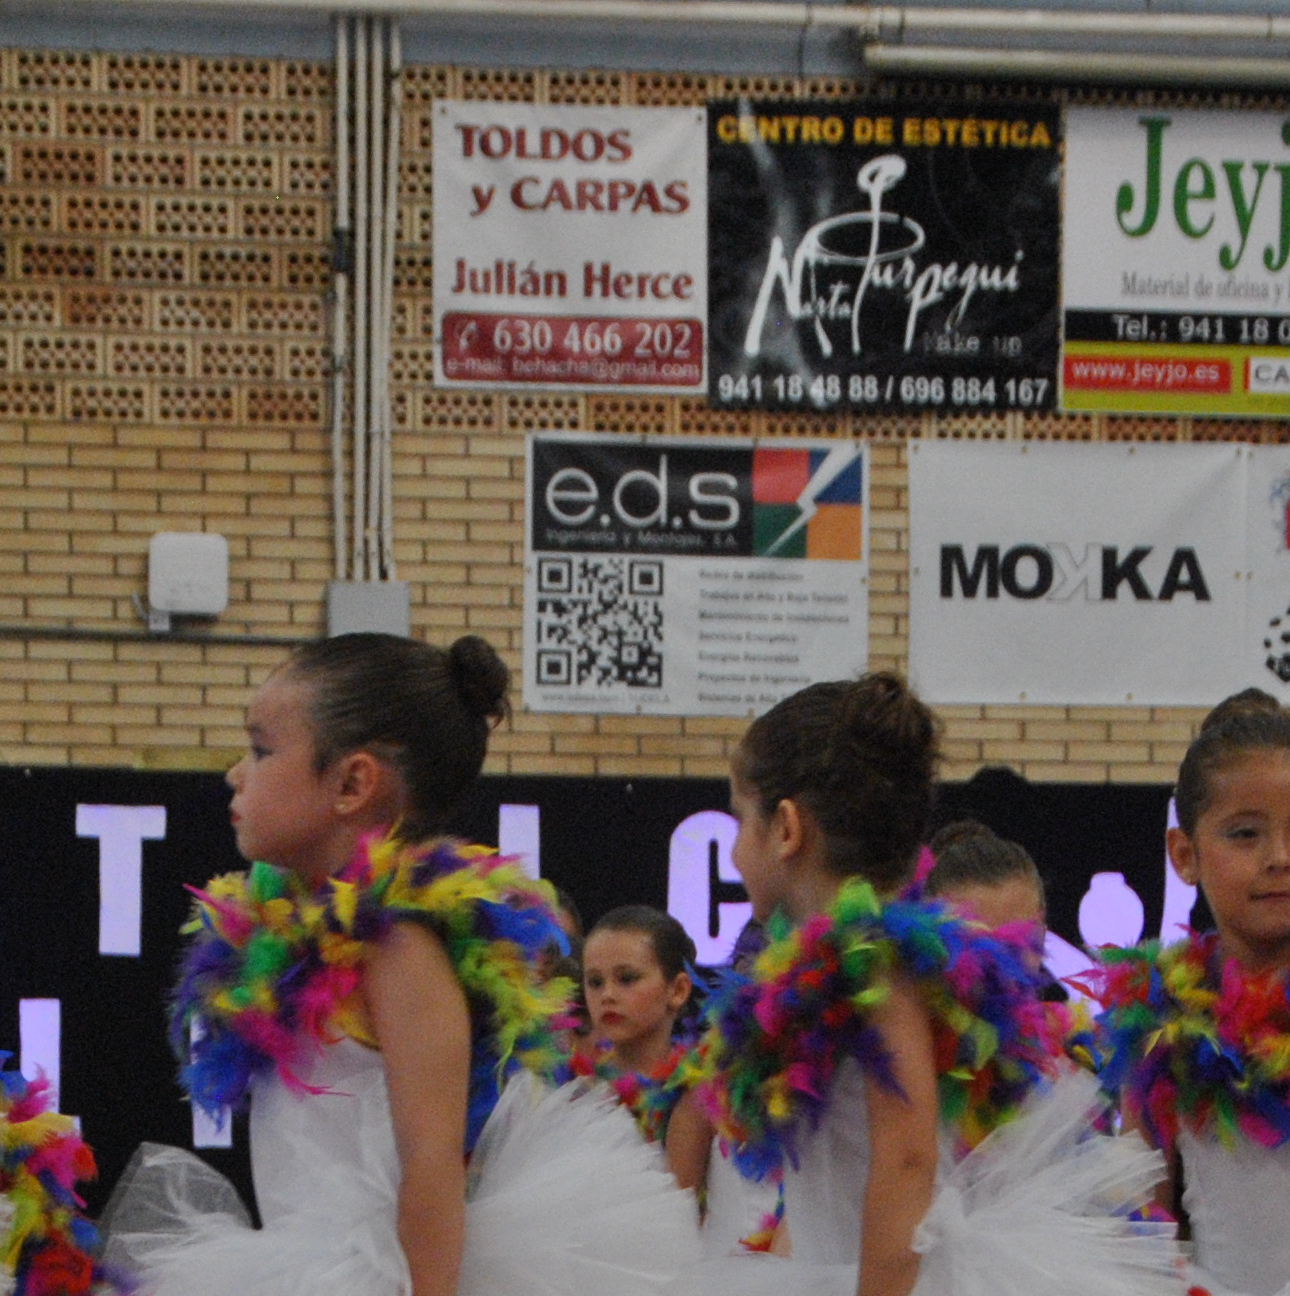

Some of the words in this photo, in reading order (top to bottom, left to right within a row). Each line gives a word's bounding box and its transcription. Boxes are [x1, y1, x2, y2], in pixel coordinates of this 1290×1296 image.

[456, 124, 632, 163] TOLDOS
[717, 116, 845, 145] CENTRO
[854, 118, 895, 146] DE
[471, 186, 495, 216] y
[509, 176, 691, 214] CARPAS
[452, 259, 568, 297] Julián
[583, 261, 694, 299] Herce
[1122, 271, 1189, 296] Material
[1194, 275, 1213, 296] de
[1216, 275, 1269, 298] oficina
[493, 319, 552, 353] 630
[563, 321, 622, 356] 466
[633, 321, 692, 359] 202
[1113, 316, 1168, 341] Tel.:
[1179, 318, 1226, 342] 941
[1239, 319, 1269, 343] 18
[1073, 358, 1220, 383] www.jeyjo.es
[718, 375, 762, 400] 941
[774, 375, 802, 401] 18
[811, 376, 841, 402] 48
[850, 376, 877, 402] 88
[901, 376, 944, 404] 696
[952, 376, 995, 404] 884
[1005, 378, 1048, 405] 167
